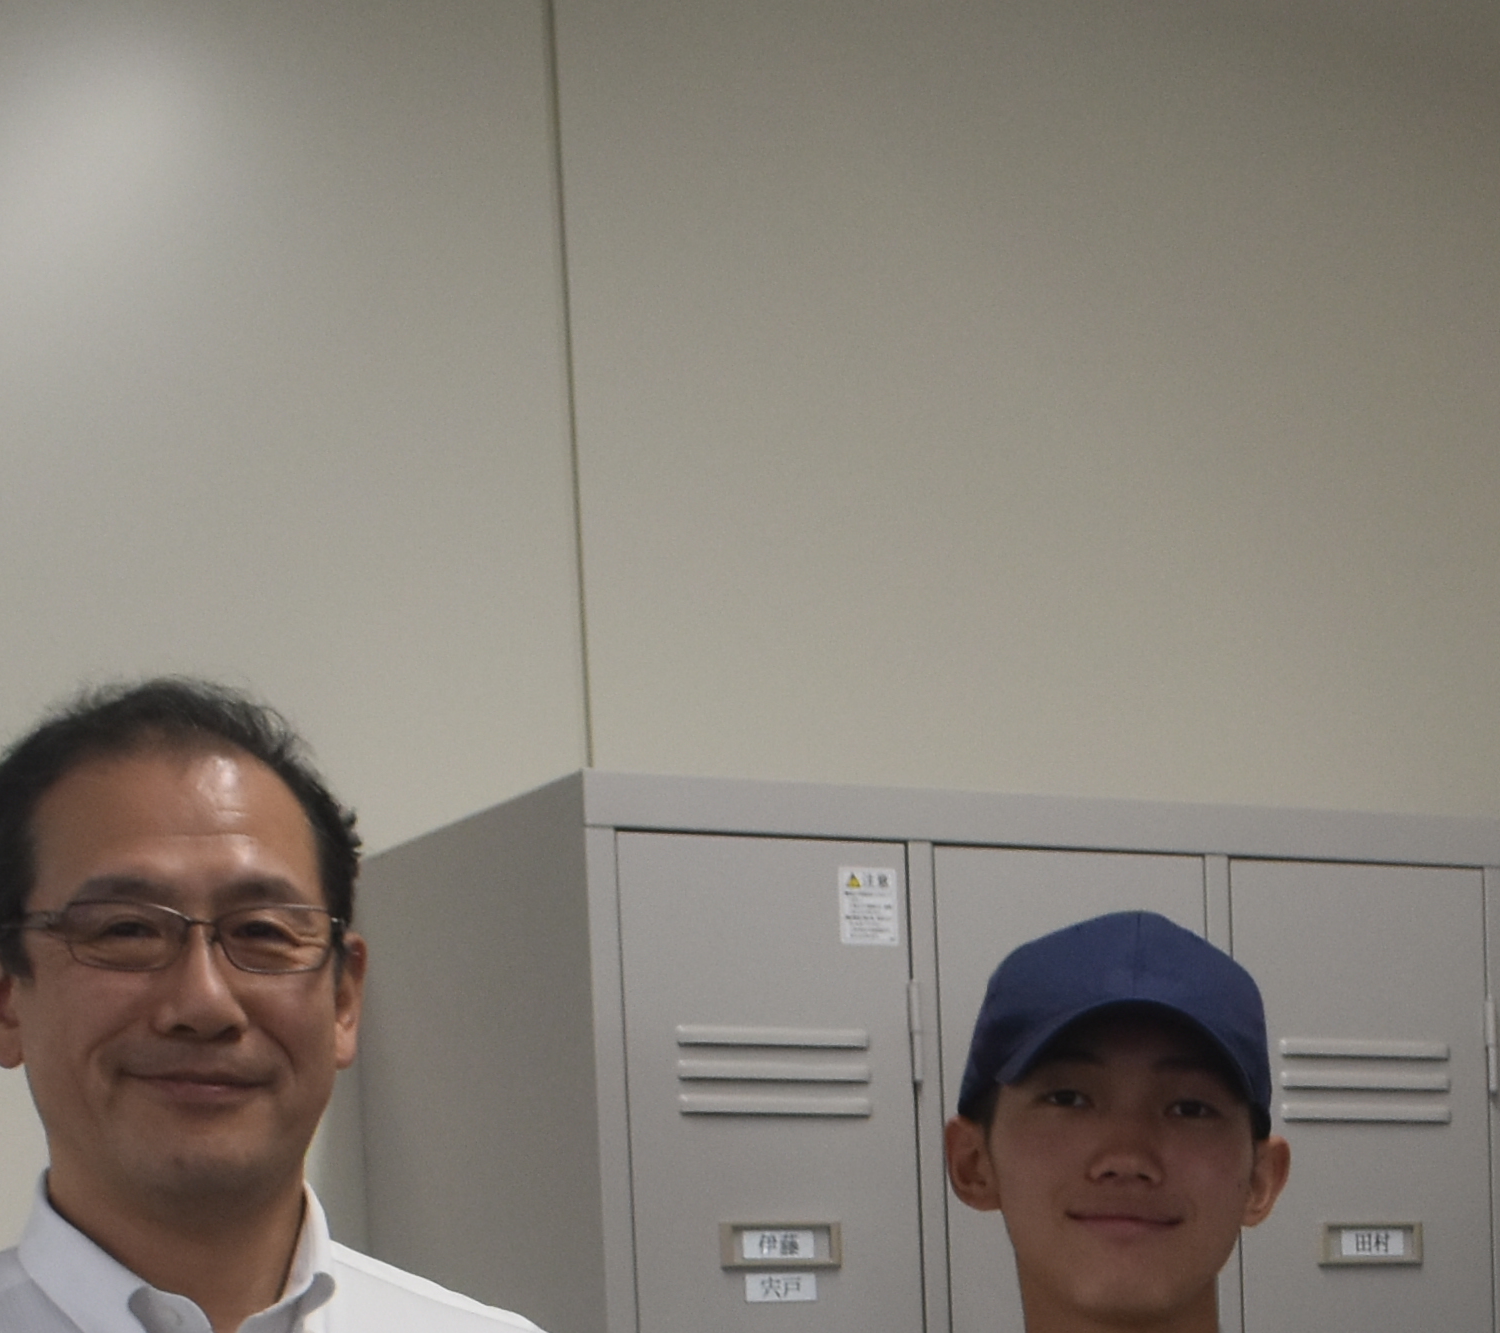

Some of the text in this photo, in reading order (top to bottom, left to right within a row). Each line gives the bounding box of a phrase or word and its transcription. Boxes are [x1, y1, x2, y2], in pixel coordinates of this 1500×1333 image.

[759, 1233, 800, 1256] 伊藤
[1355, 1233, 1390, 1253] 田村
[760, 1276, 802, 1298] 宍戸
